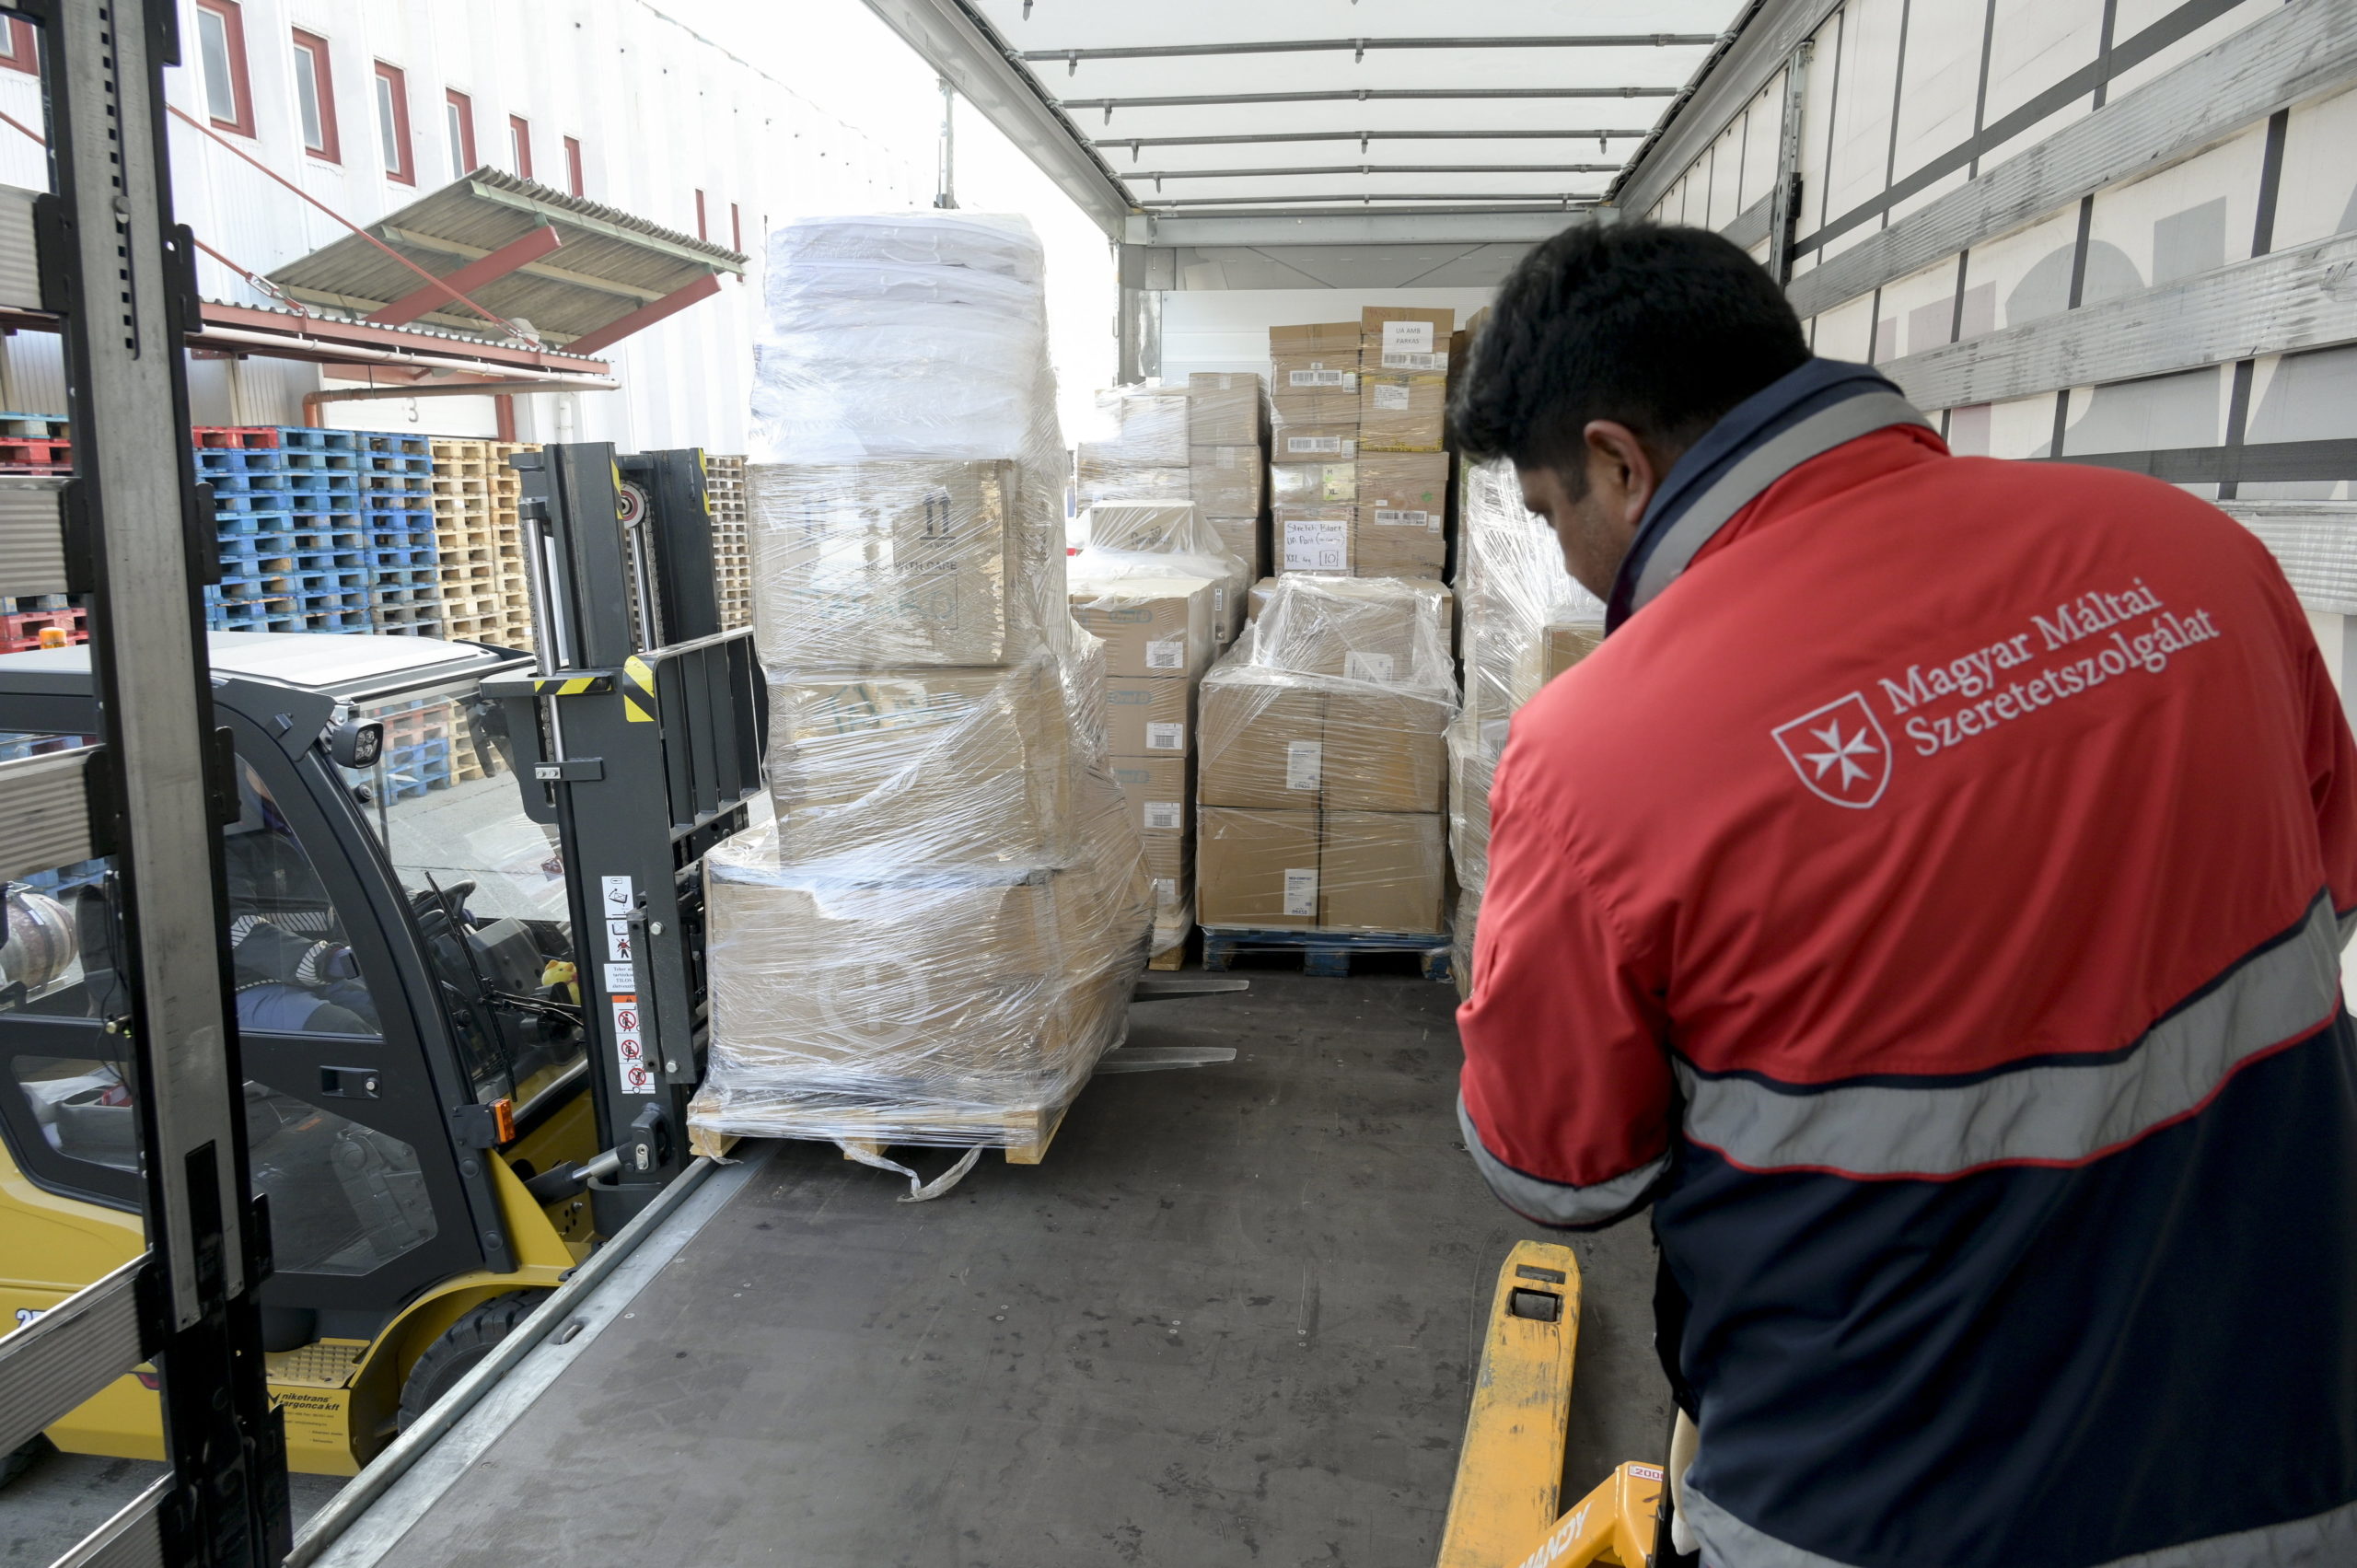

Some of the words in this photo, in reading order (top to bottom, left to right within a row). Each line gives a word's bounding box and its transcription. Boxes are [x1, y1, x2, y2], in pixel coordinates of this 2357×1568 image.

[406, 397, 419, 423] 3
[926, 561, 958, 570] CARE
[1876, 633, 2034, 714] Magyar
[2030, 576, 2163, 651] Máltai
[1905, 609, 2221, 756] Szeretetszolgálat
[282, 1392, 330, 1403] niketrans
